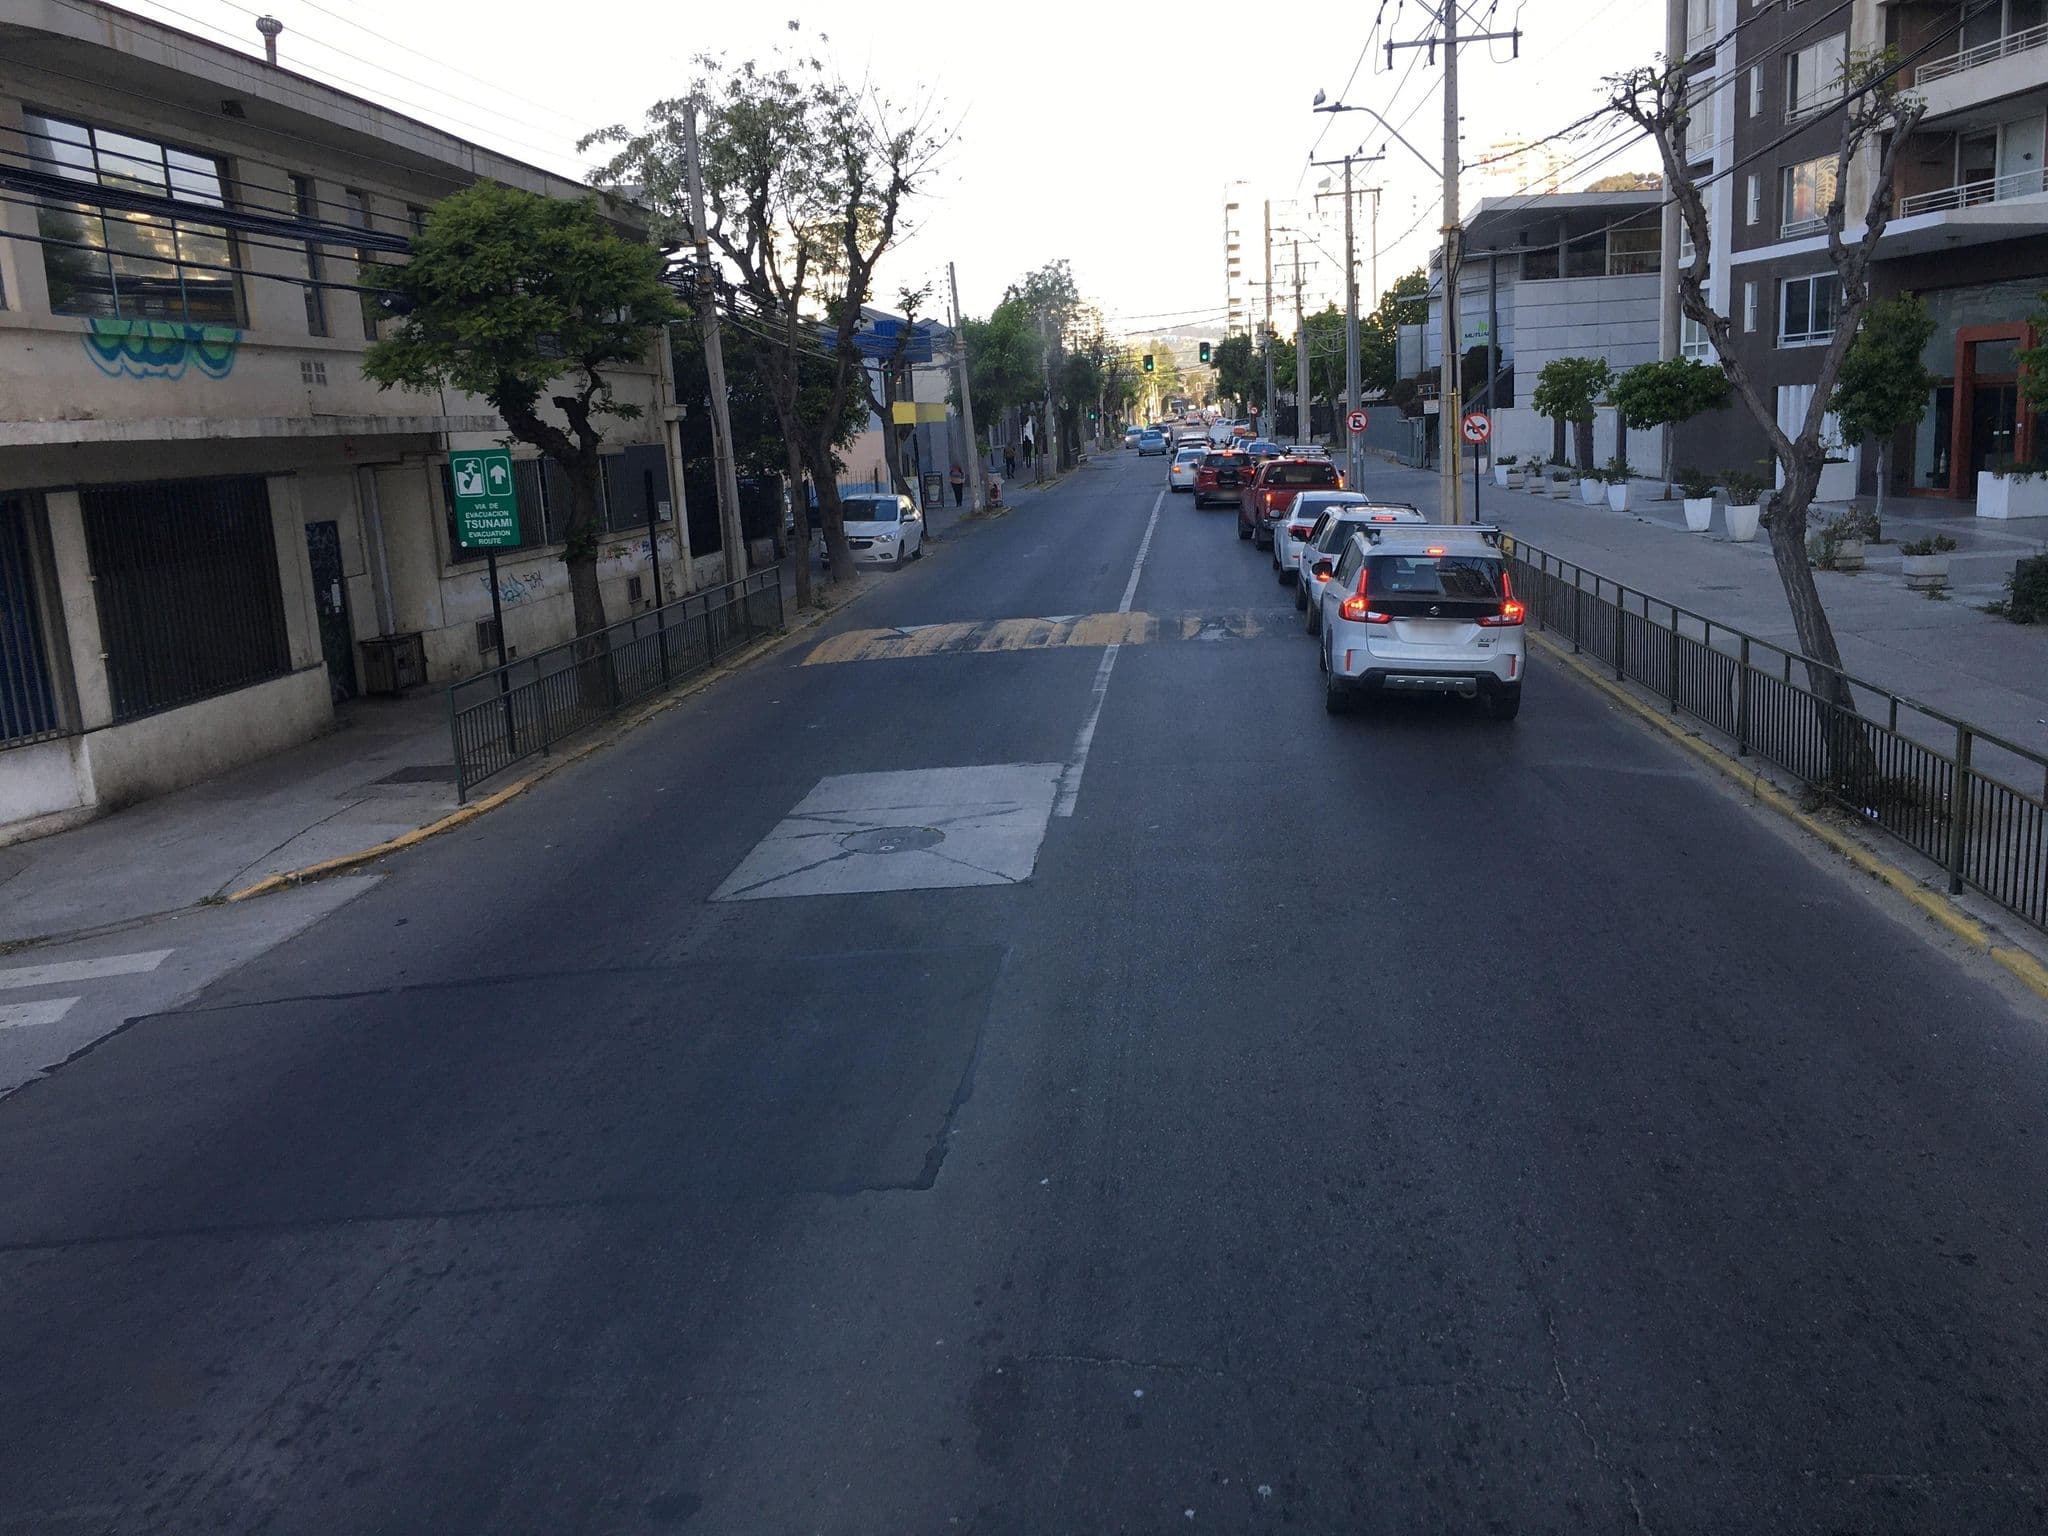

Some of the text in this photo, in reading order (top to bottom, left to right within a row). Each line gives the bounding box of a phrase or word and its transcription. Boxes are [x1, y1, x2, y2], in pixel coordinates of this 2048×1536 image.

[465, 510, 509, 518] EVACUACION
[464, 518, 513, 529] TSUNAMI
[468, 530, 511, 538] EVACUATION
